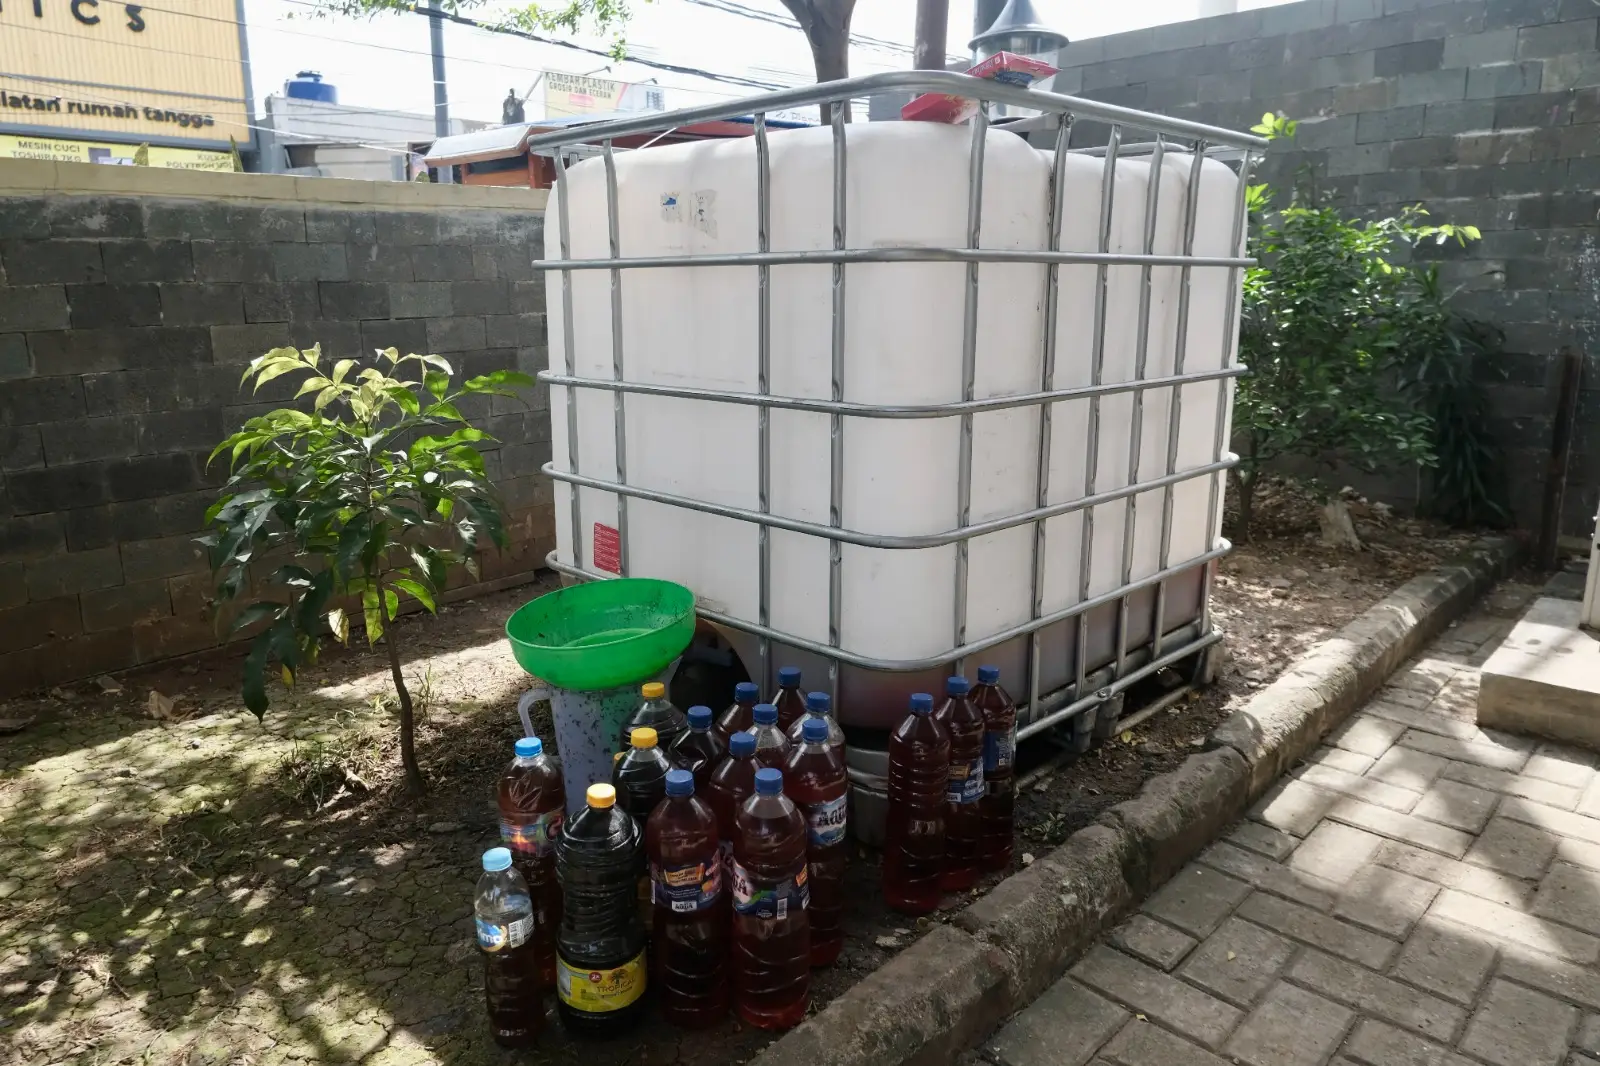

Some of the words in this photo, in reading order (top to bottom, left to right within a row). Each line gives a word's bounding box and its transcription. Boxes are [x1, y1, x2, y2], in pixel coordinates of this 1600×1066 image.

[0, 0, 145, 32] ICS
[545, 72, 579, 86] KEMBAR
[582, 76, 616, 93] PLASTIK
[549, 81, 573, 93] GROSIR
[574, 85, 587, 95] DAN
[589, 88, 612, 99] ECERAN
[67, 100, 138, 120] rumah
[142, 106, 215, 128] tangga
[12, 151, 58, 161] TOSHIBA
[18, 141, 51, 151] MESIN
[54, 144, 80, 153] CUCI
[597, 977, 635, 993] TROPICAL
